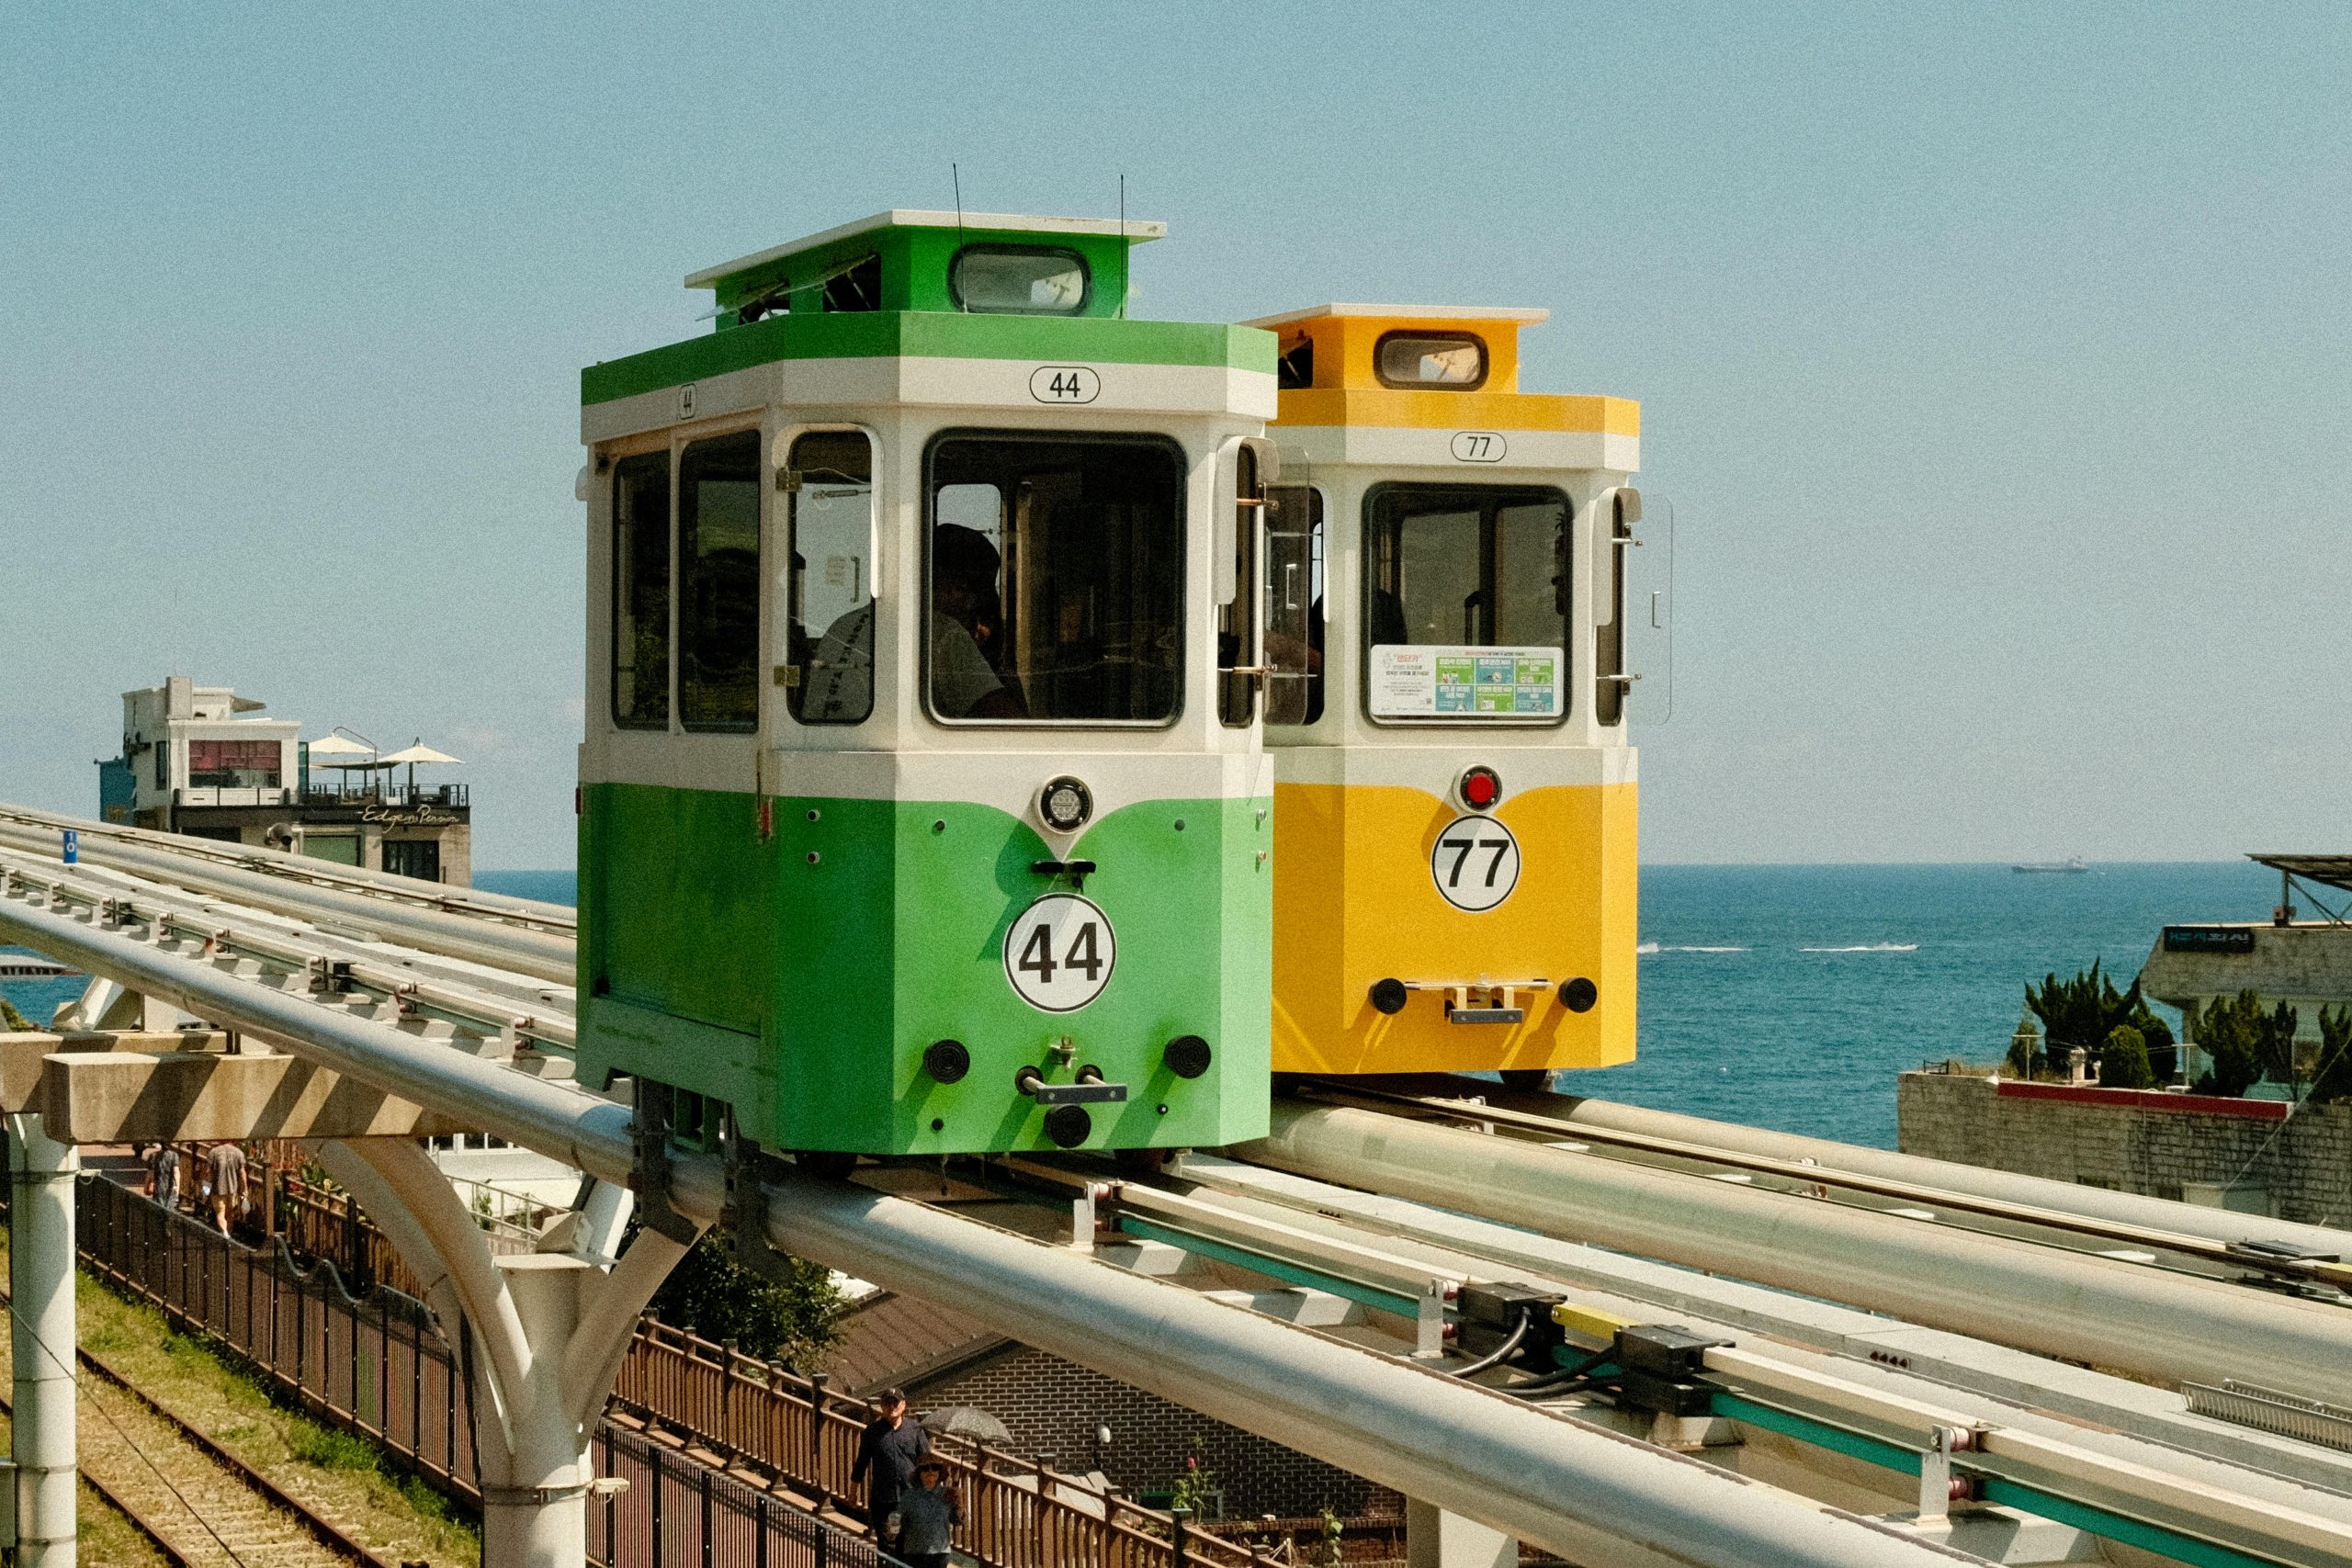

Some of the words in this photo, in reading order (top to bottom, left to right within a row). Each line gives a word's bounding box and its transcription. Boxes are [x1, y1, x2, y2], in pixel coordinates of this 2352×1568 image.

[1049, 372, 1080, 398] 44
[1467, 436, 1490, 457] 77
[1442, 839, 1510, 887] 77
[1018, 922, 1102, 983] 44
